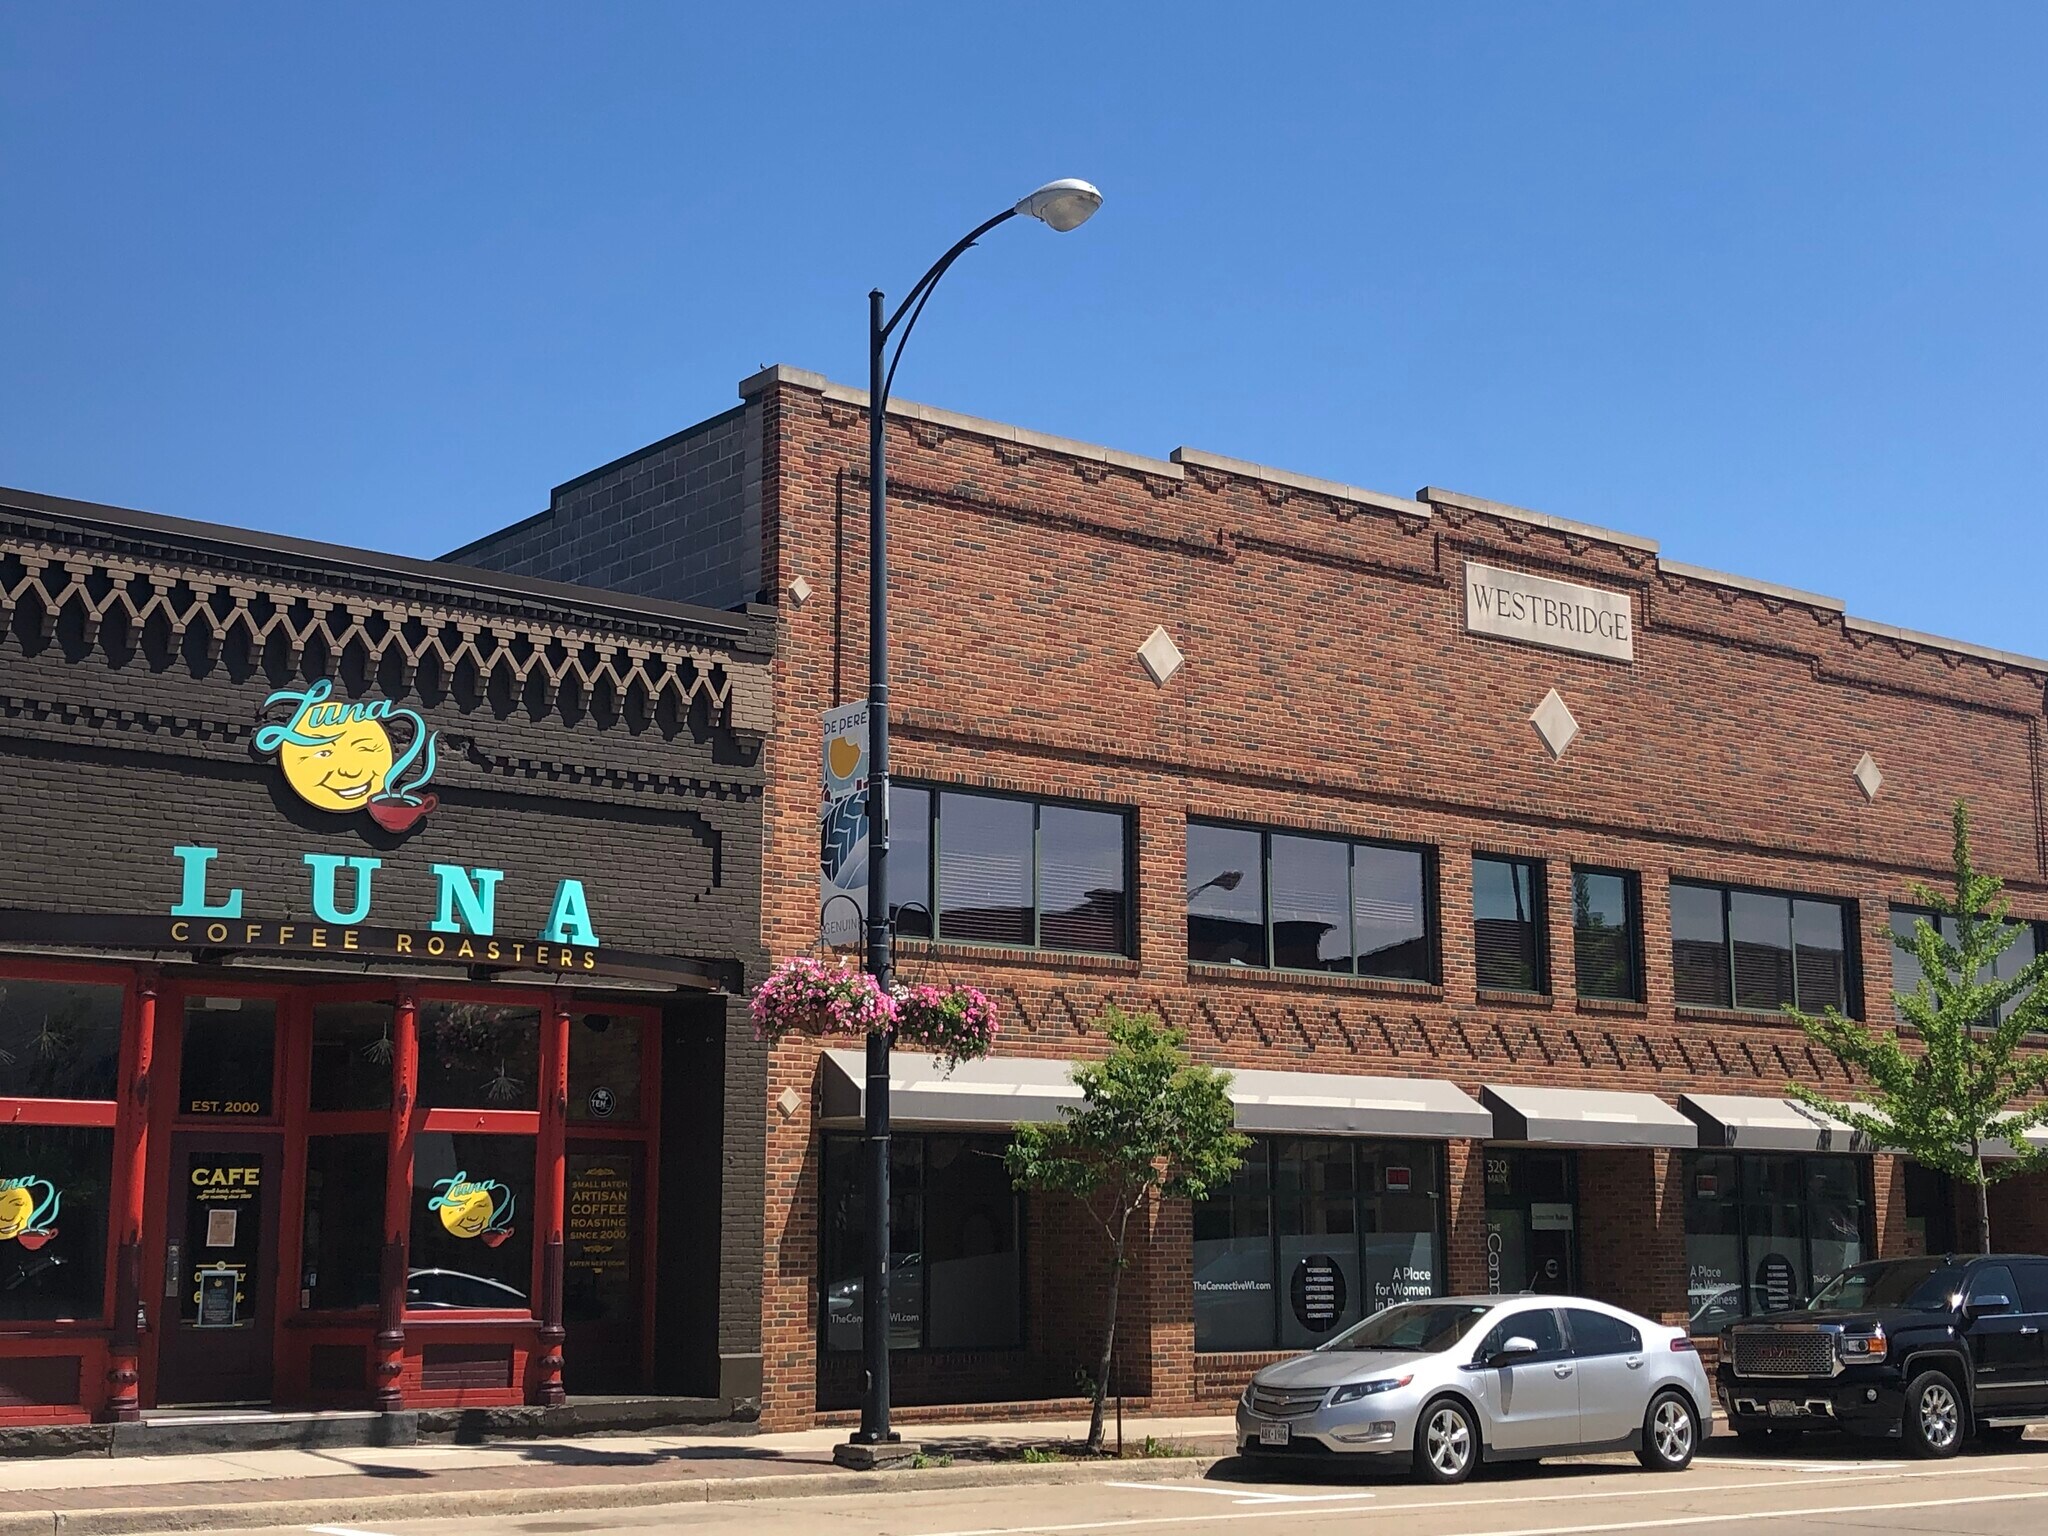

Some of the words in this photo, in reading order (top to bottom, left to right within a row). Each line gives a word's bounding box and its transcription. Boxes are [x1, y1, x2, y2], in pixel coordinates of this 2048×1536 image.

[1472, 583, 1628, 642] WESTBRIDGE
[255, 680, 393, 751] Luna
[824, 721, 837, 735] DE
[839, 711, 867, 735] PERE
[170, 845, 600, 948] LUNA
[171, 922, 359, 950] COFFEE
[397, 933, 596, 969] ROASTERS
[191, 1101, 221, 1112] EST.
[224, 1102, 260, 1113] 2000
[1487, 1160, 1507, 1174] 320
[191, 1168, 260, 1186] CAFE
[1487, 1174, 1507, 1184] MAIN
[428, 1171, 496, 1211] Luna
[571, 1181, 599, 1189] SMALL
[571, 1191, 627, 1201] ARTISAN
[571, 1204, 626, 1215] COFFEE
[571, 1218, 627, 1228] ROASTING
[1487, 1223, 1501, 1231] THE
[570, 1231, 599, 1240] SINCE
[600, 1230, 627, 1239] 2000
[1392, 1267, 1401, 1280] A
[1403, 1266, 1431, 1280] Place
[1690, 1265, 1697, 1278] A
[1698, 1265, 1721, 1278] Place
[1193, 1280, 1271, 1291] TheConnectiveWI.com
[1375, 1282, 1390, 1296] for
[1391, 1282, 1432, 1296] Women
[1690, 1279, 1703, 1291] for
[1703, 1279, 1737, 1292] Women
